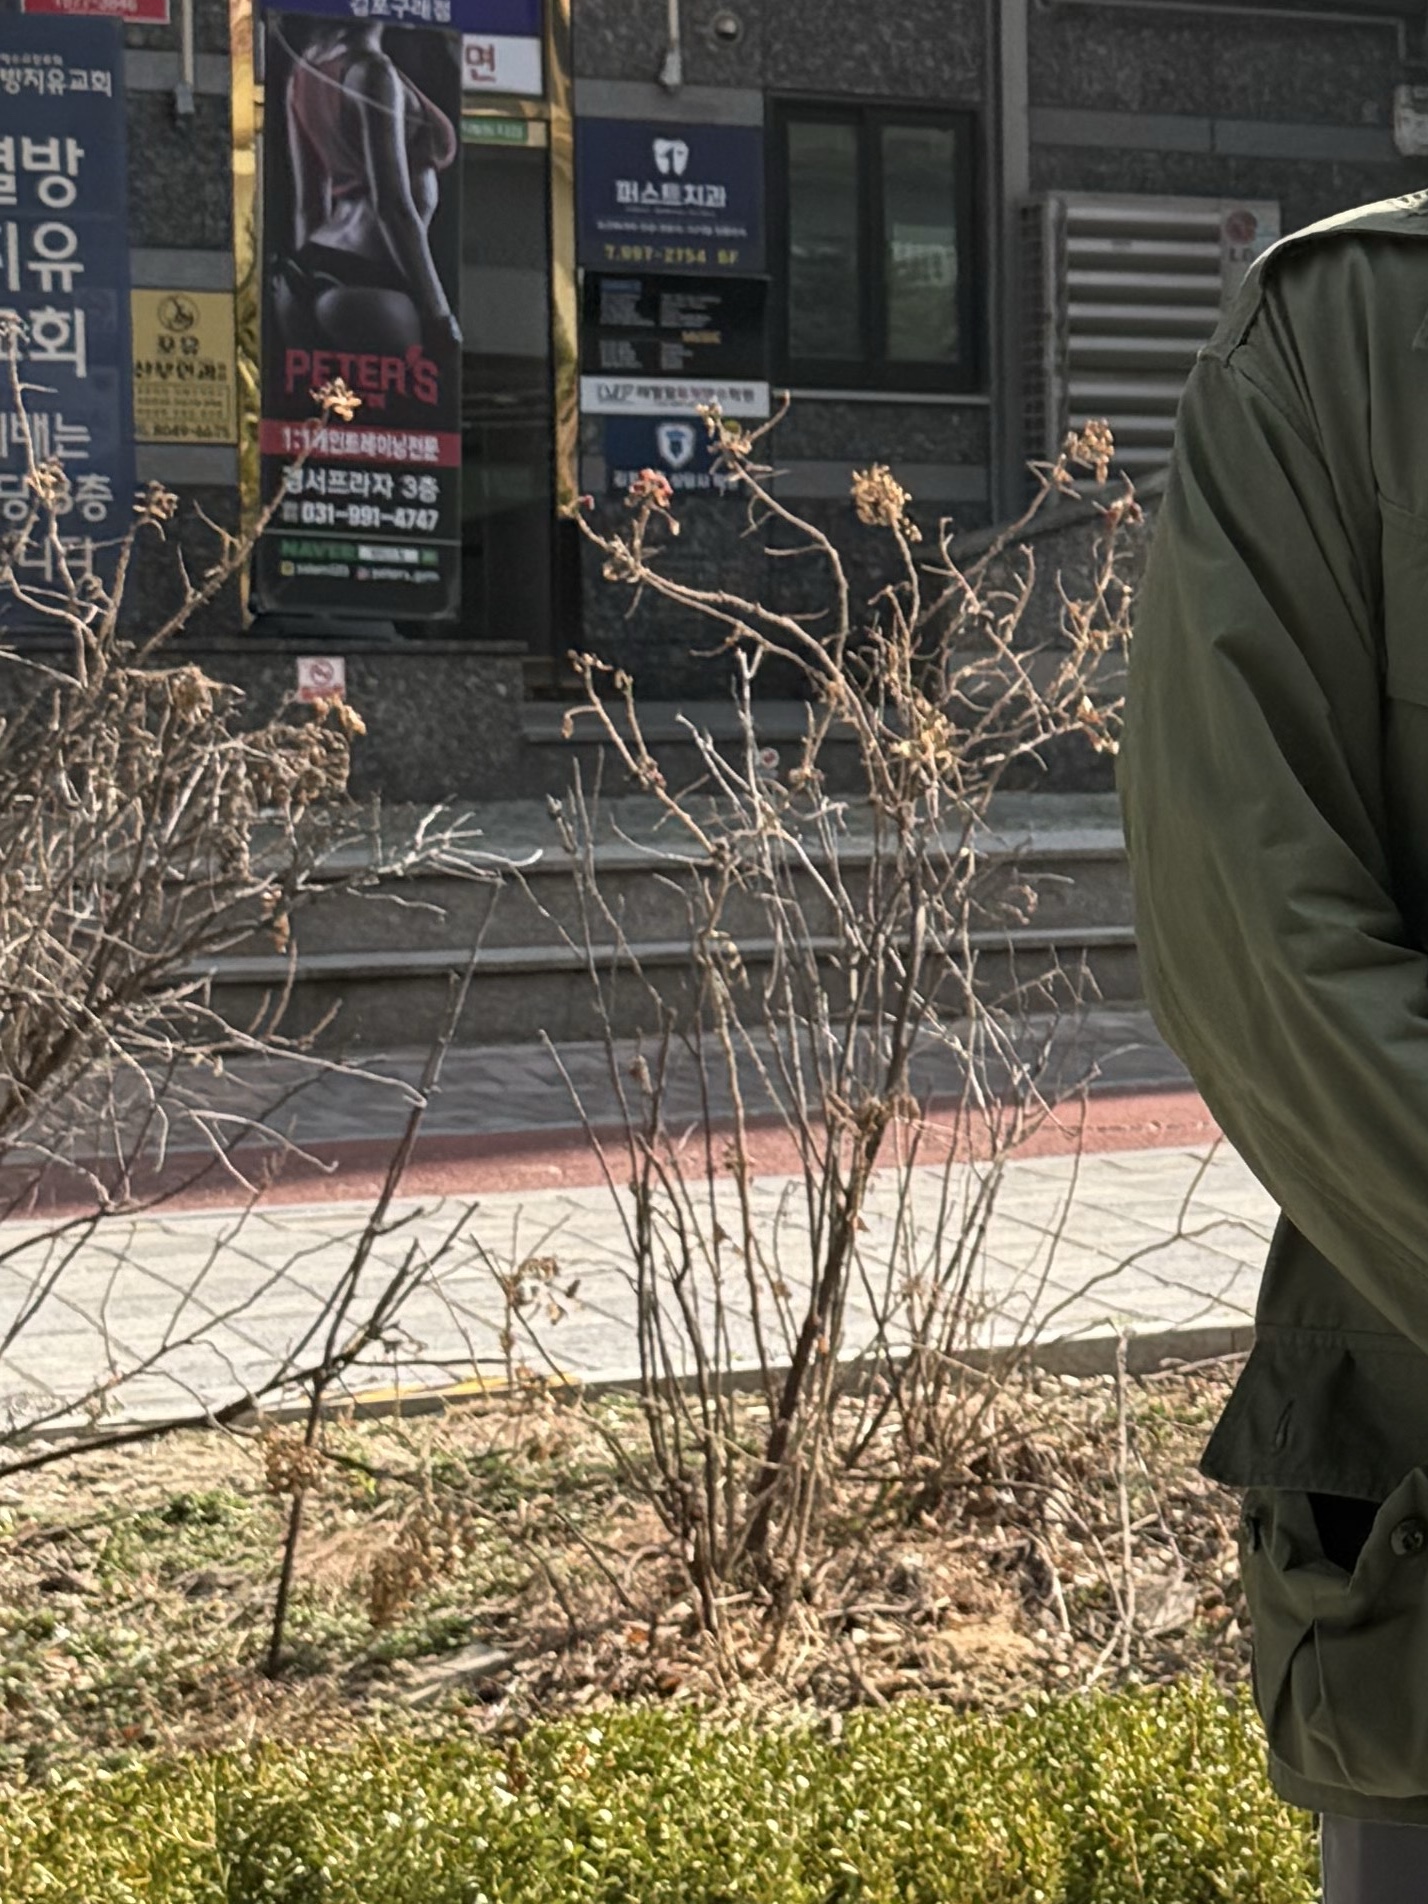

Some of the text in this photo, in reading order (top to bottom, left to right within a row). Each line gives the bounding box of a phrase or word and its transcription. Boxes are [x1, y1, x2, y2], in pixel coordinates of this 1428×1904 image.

[615, 179, 727, 208] 퍼스트치과
[284, 344, 440, 407] PETER'S
[400, 474, 441, 505] 3층
[301, 500, 440, 533] 031-991-4747
